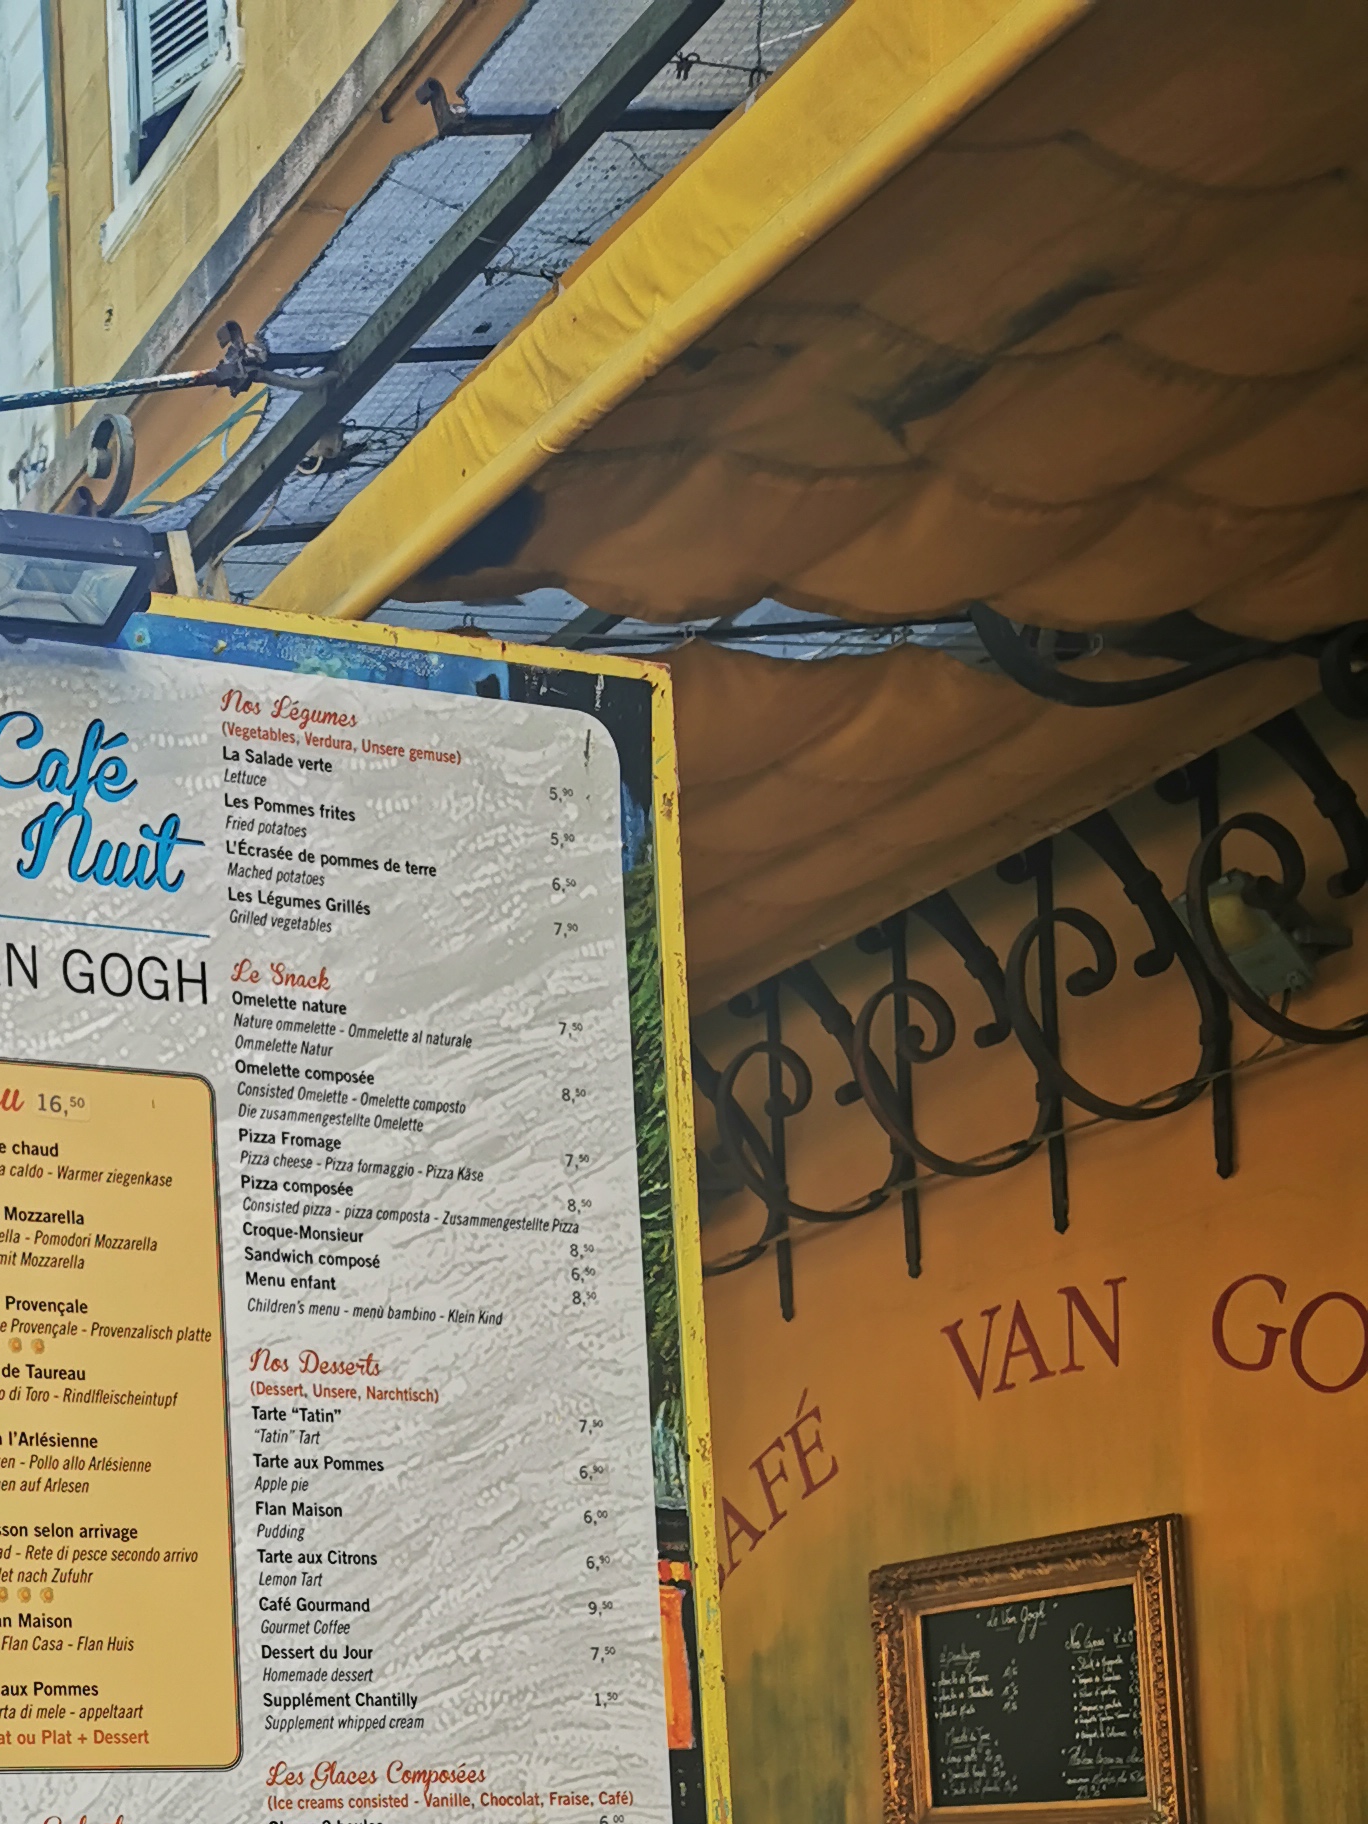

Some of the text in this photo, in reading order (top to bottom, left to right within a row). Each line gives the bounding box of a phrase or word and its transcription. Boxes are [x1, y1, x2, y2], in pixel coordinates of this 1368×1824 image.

[219, 687, 358, 731] Nos Légumes
[223, 767, 267, 787] Lettuce
[16, 800, 206, 894] Nuit
[61, 947, 208, 1006] GOGH
[229, 957, 331, 991] Le Snack
[230, 989, 347, 1016] Omelette nature
[10, 1139, 59, 1158] chaud
[237, 1126, 342, 1153] Pizza Fromage
[241, 1220, 364, 1243] Croque-Monsieur
[4, 1294, 88, 1317] Provençale
[248, 1346, 382, 1377] Nos Desserts
[718, 1272, 1368, 1591] AFÉ VAN GO
[253, 1475, 309, 1495] Apple pie
[257, 1595, 371, 1613] Café Gourmand
[17, 1611, 73, 1629] Maison
[0, 1683, 29, 1697] aux
[32, 1680, 99, 1697] Pommes
[264, 1759, 488, 1796] Les Glaces Composées
